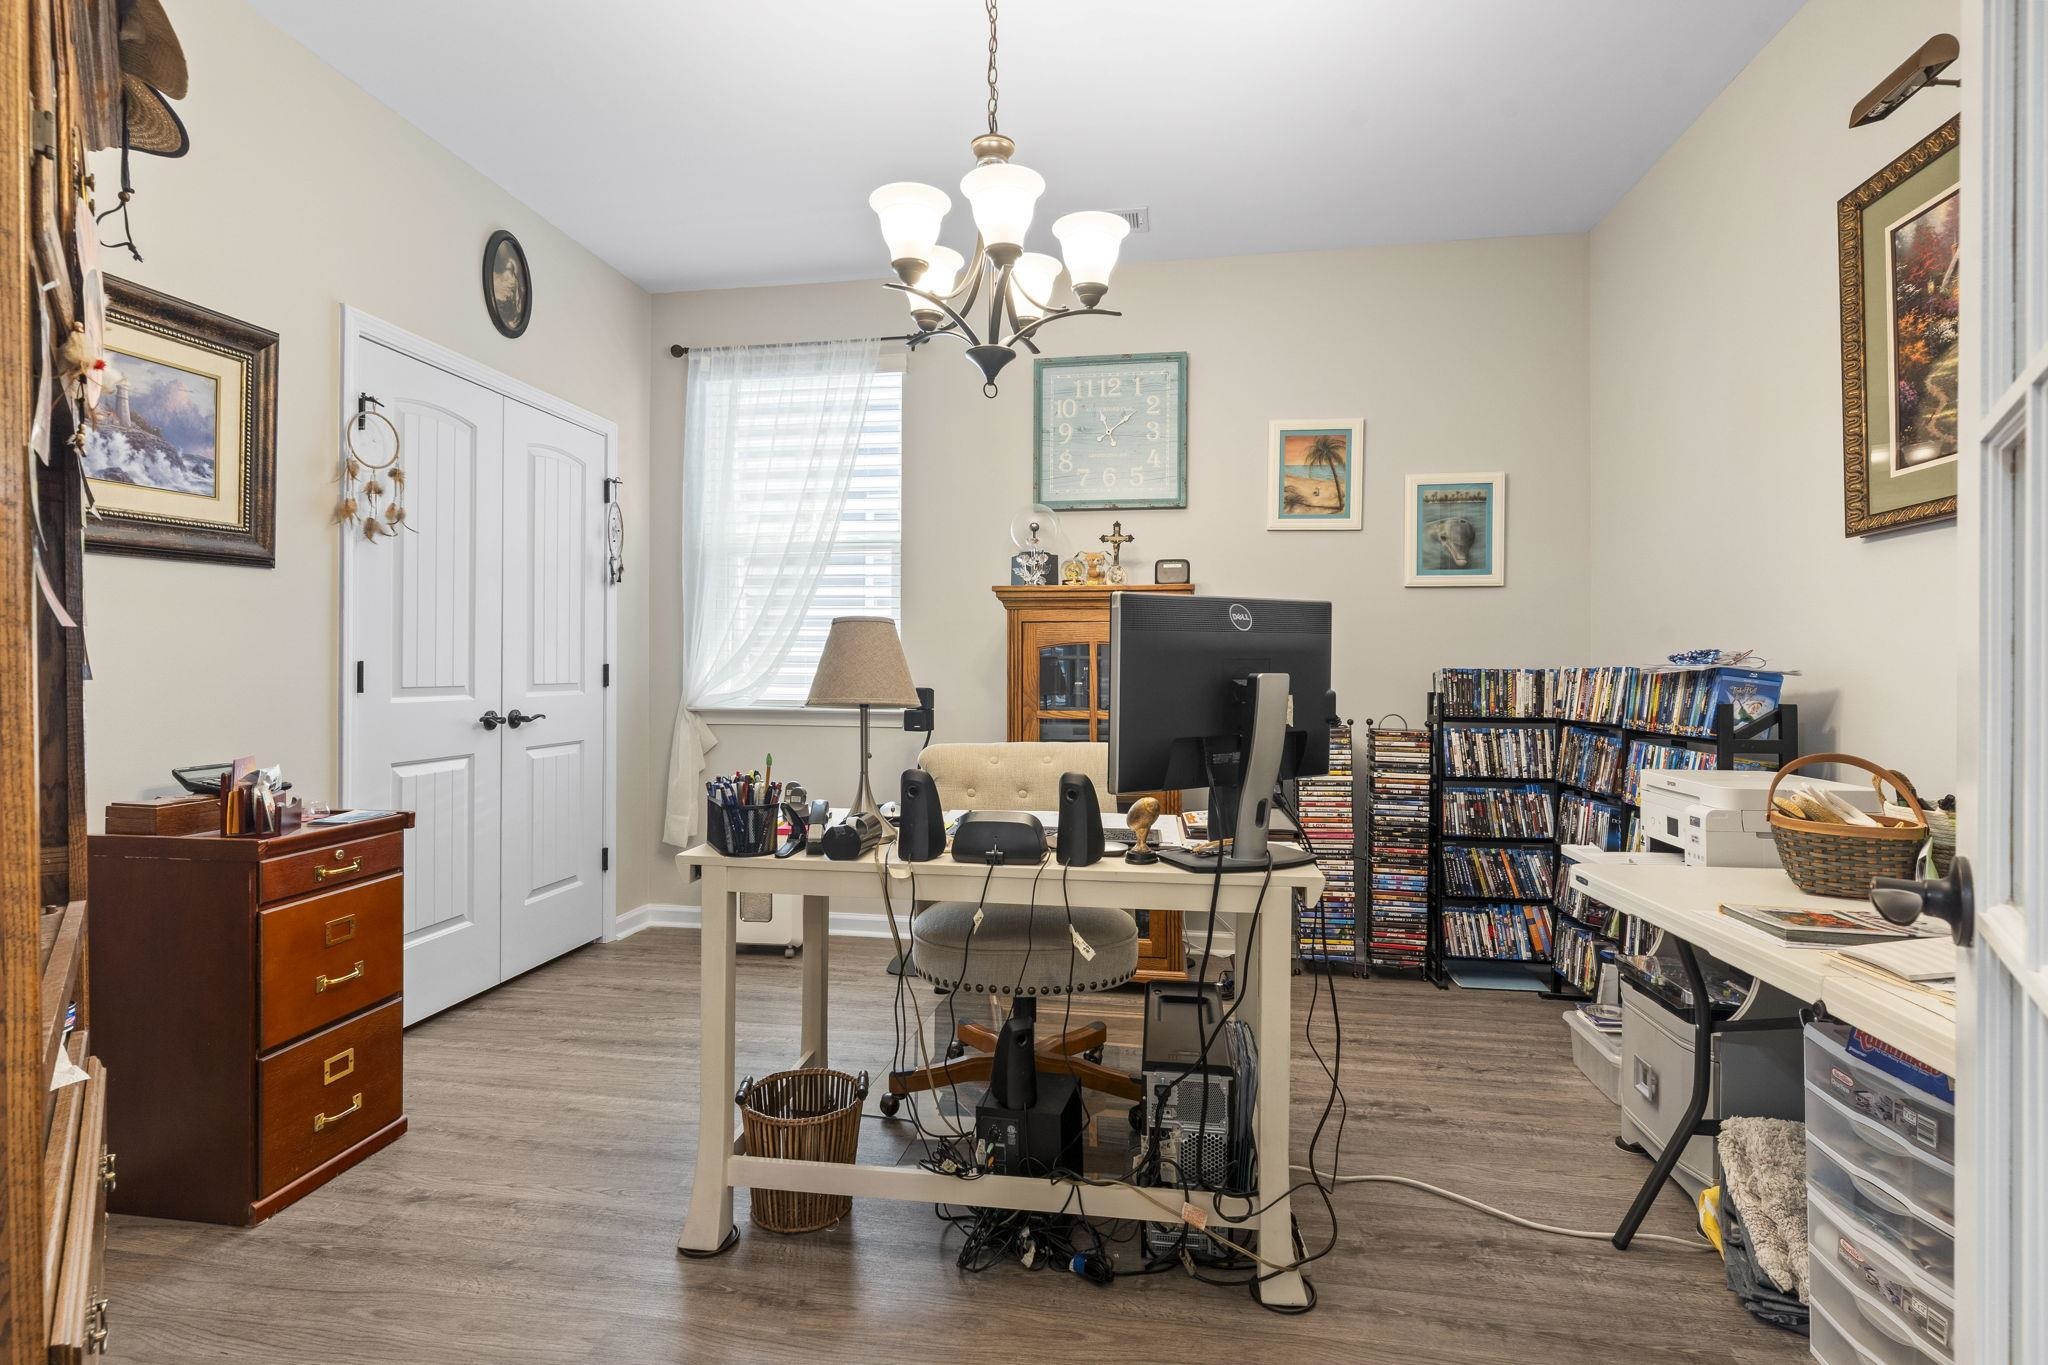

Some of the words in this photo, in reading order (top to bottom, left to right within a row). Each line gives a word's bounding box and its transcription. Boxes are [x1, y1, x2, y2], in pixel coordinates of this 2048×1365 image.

[1074, 379, 1093, 398] 11
[1098, 378, 1121, 397] 12
[1134, 376, 1142, 396] 1
[1056, 399, 1077, 418] 10
[1146, 395, 1160, 415] 2
[1058, 423, 1072, 444] 9
[1146, 421, 1159, 440] 3
[1058, 449, 1072, 472] 8
[1146, 449, 1160, 468] 4
[1076, 468, 1089, 486] 7
[1102, 466, 1117, 486] 6
[1129, 465, 1144, 487] 5
[1232, 613, 1250, 621] DELL
